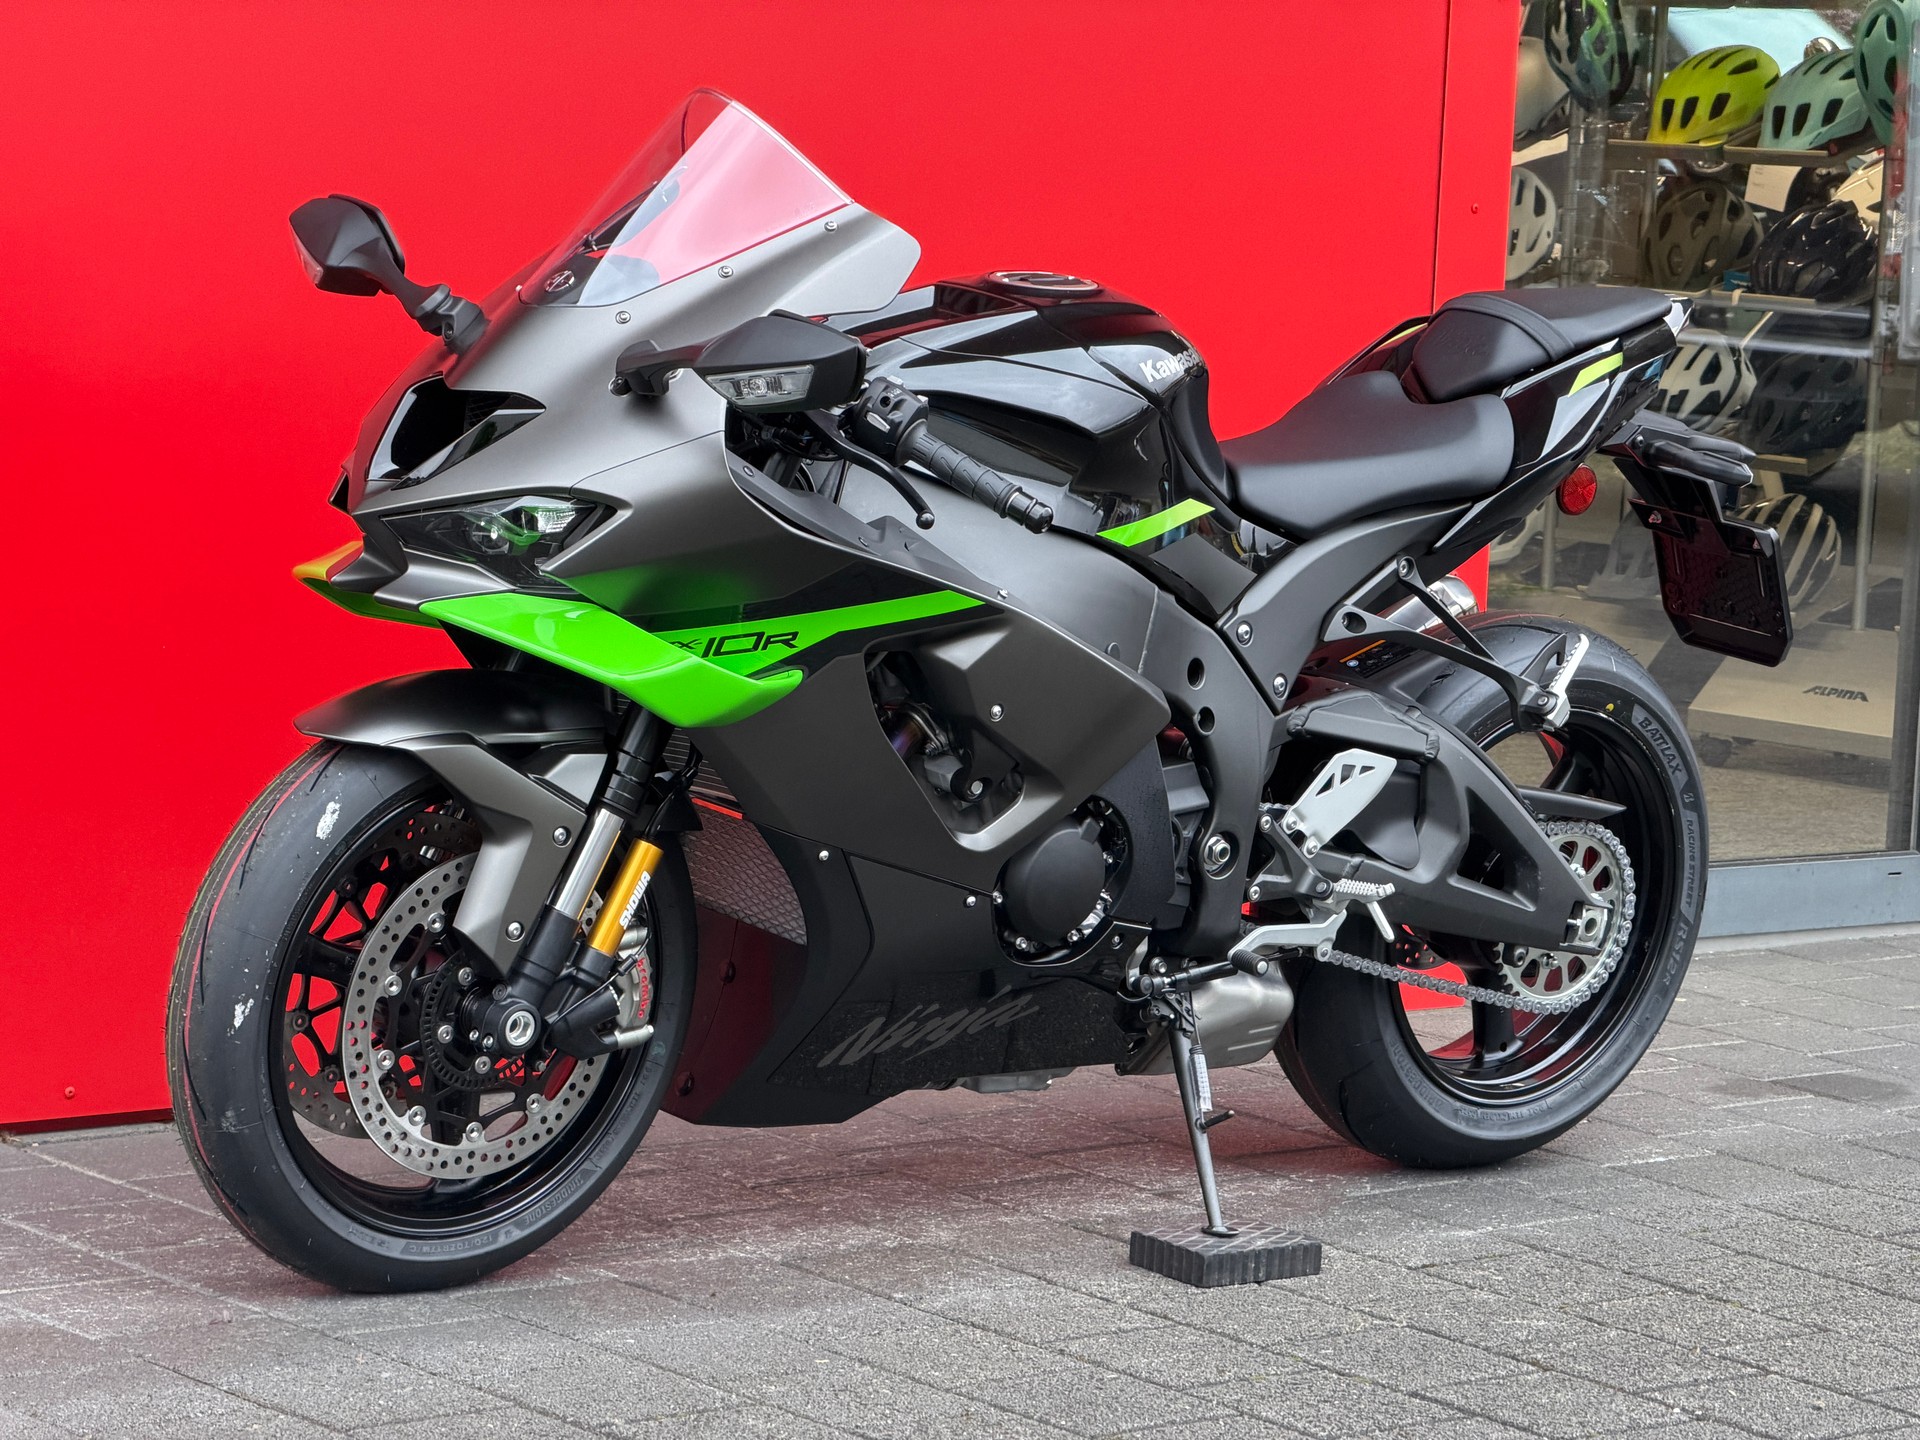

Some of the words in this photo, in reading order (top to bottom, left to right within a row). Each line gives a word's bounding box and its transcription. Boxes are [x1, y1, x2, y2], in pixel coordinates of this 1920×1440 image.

[1139, 347, 1203, 383] Kawasa
[669, 631, 799, 658] X-10R
[1802, 685, 1869, 702] ALPINA
[1638, 716, 1682, 776] BATTLAX
[1687, 819, 1696, 864] RACING
[619, 870, 652, 930] SHOWA
[1686, 864, 1696, 908] STREET
[817, 984, 1040, 1068] Ninja
[523, 1175, 585, 1225] BRIDGESTONE
